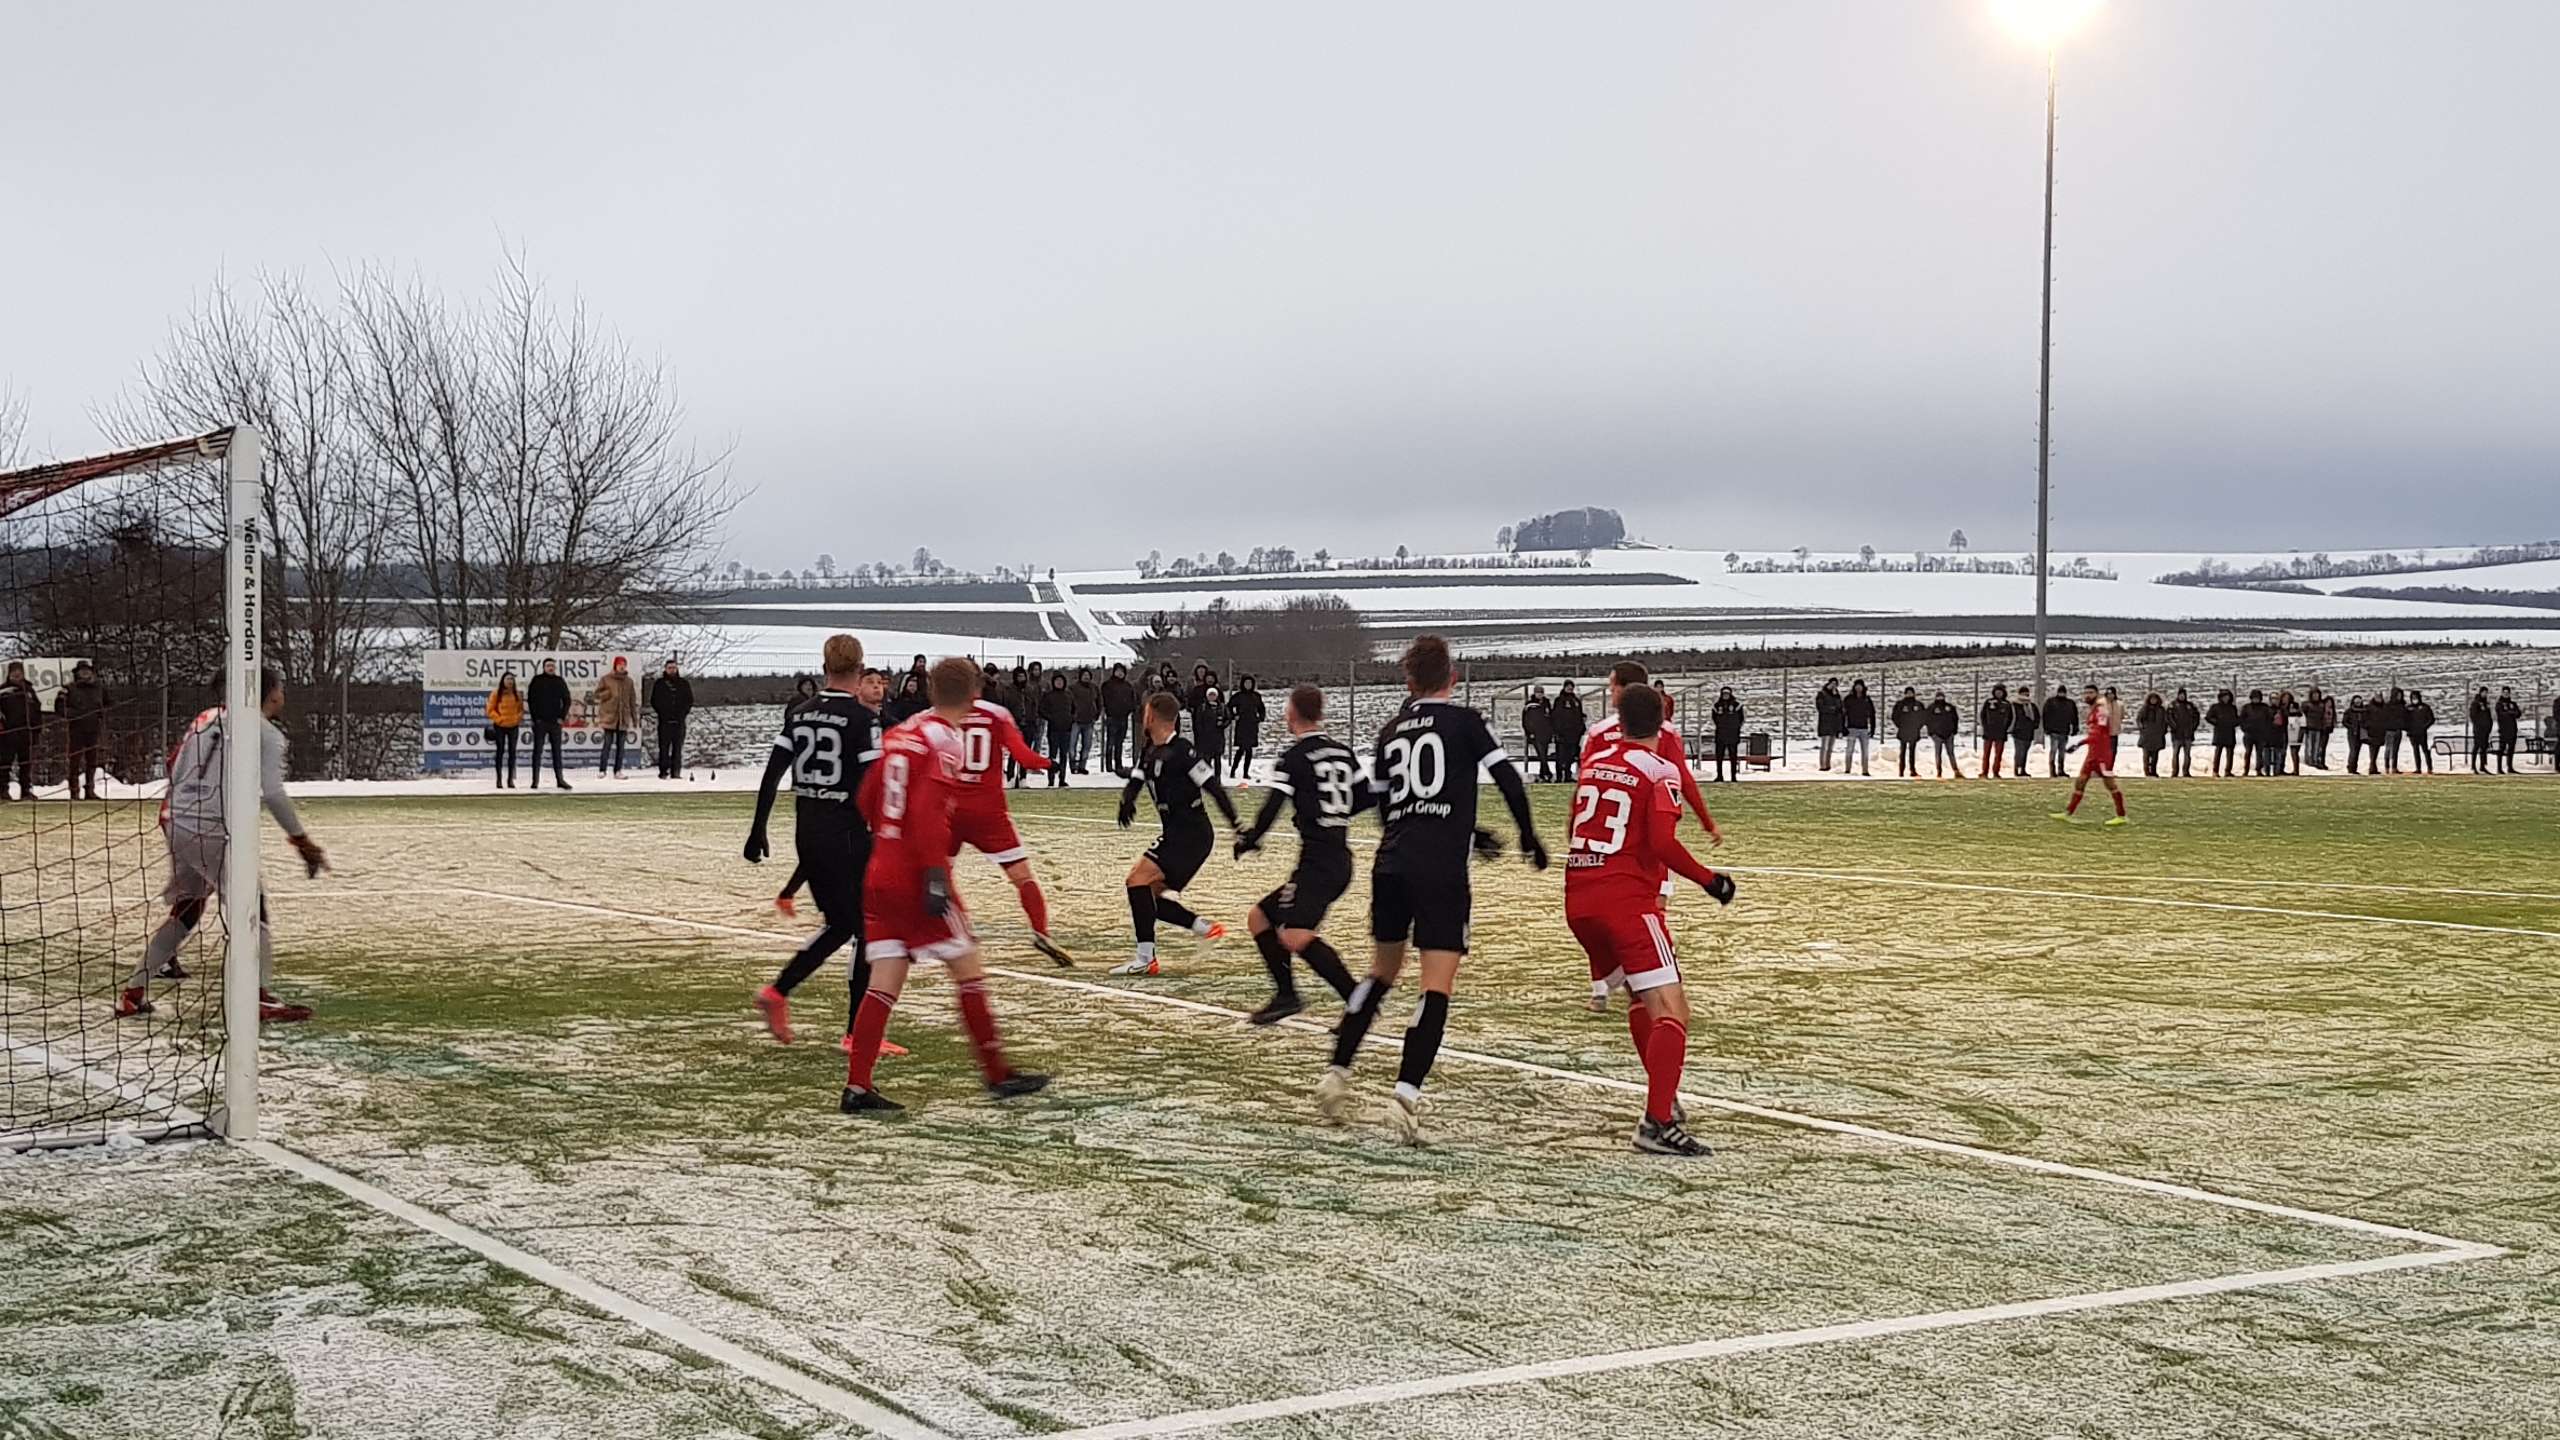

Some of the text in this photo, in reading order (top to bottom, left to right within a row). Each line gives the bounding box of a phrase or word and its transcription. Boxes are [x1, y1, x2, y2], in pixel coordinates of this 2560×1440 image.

[245, 577, 255, 590] &
[244, 594, 256, 661] Herden
[465, 658, 541, 678] SAFETY
[792, 725, 842, 786] 23
[1384, 732, 1445, 804] 30
[1415, 800, 1451, 819] Group
[1570, 784, 1632, 855] 23
[1568, 853, 1606, 868] SCHIELE
